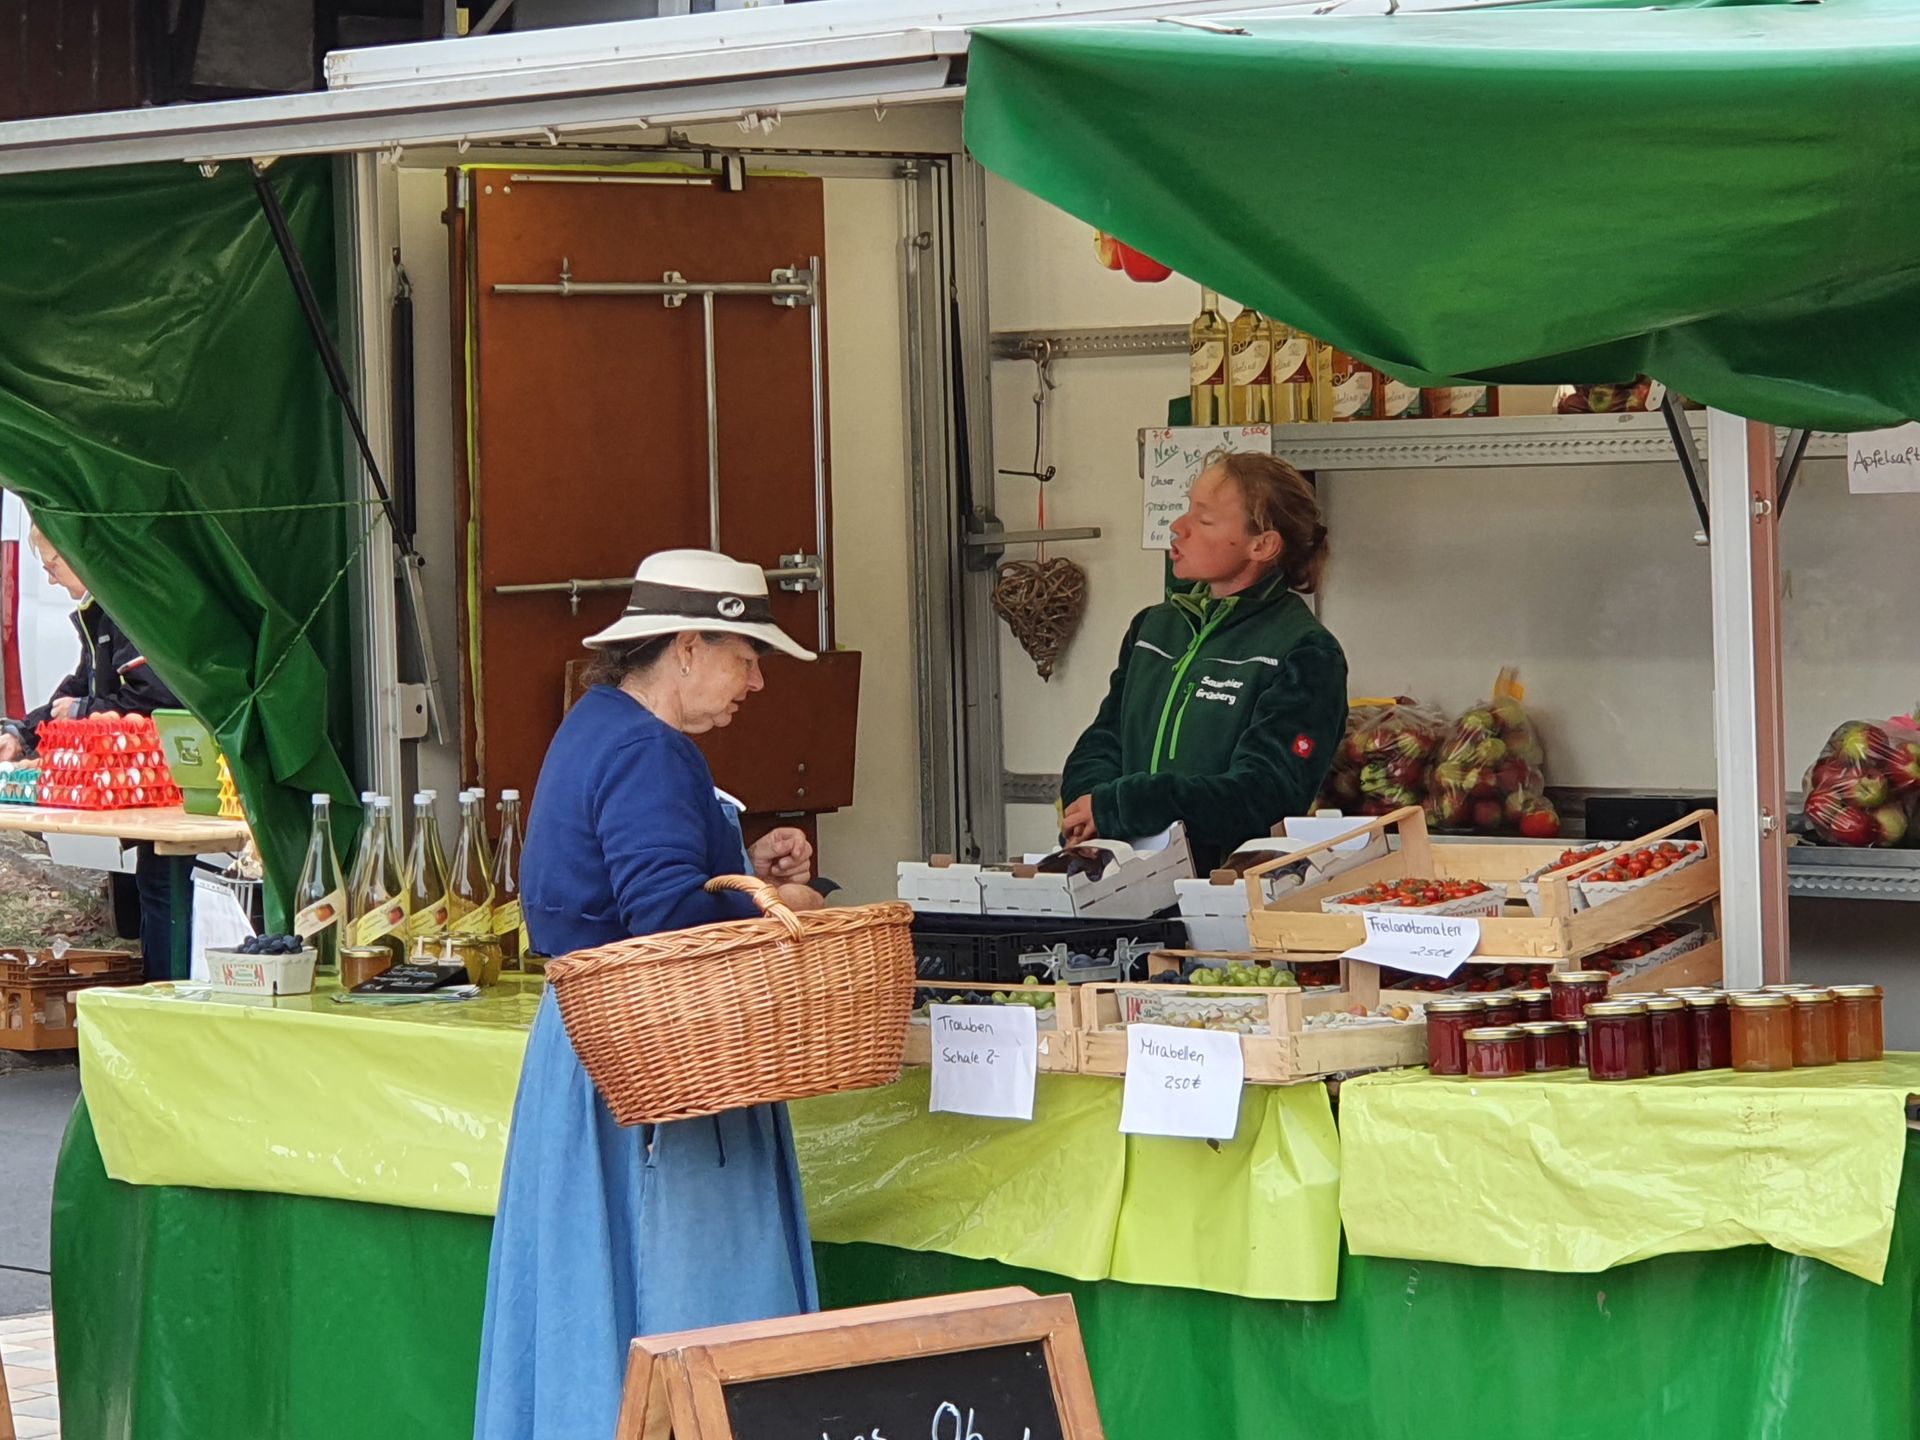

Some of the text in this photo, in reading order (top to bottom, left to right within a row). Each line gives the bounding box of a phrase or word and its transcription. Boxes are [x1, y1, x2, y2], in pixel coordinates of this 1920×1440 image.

[1153, 440, 1179, 464] Neu
[1853, 446, 1920, 474] Apfelsaft
[1367, 916, 1462, 938] Freilandtomaten
[937, 1015, 994, 1035] Trauben
[942, 1047, 980, 1064] Schale
[1140, 1037, 1205, 1066] Mirabellen
[1164, 1075, 1203, 1090] 250€
